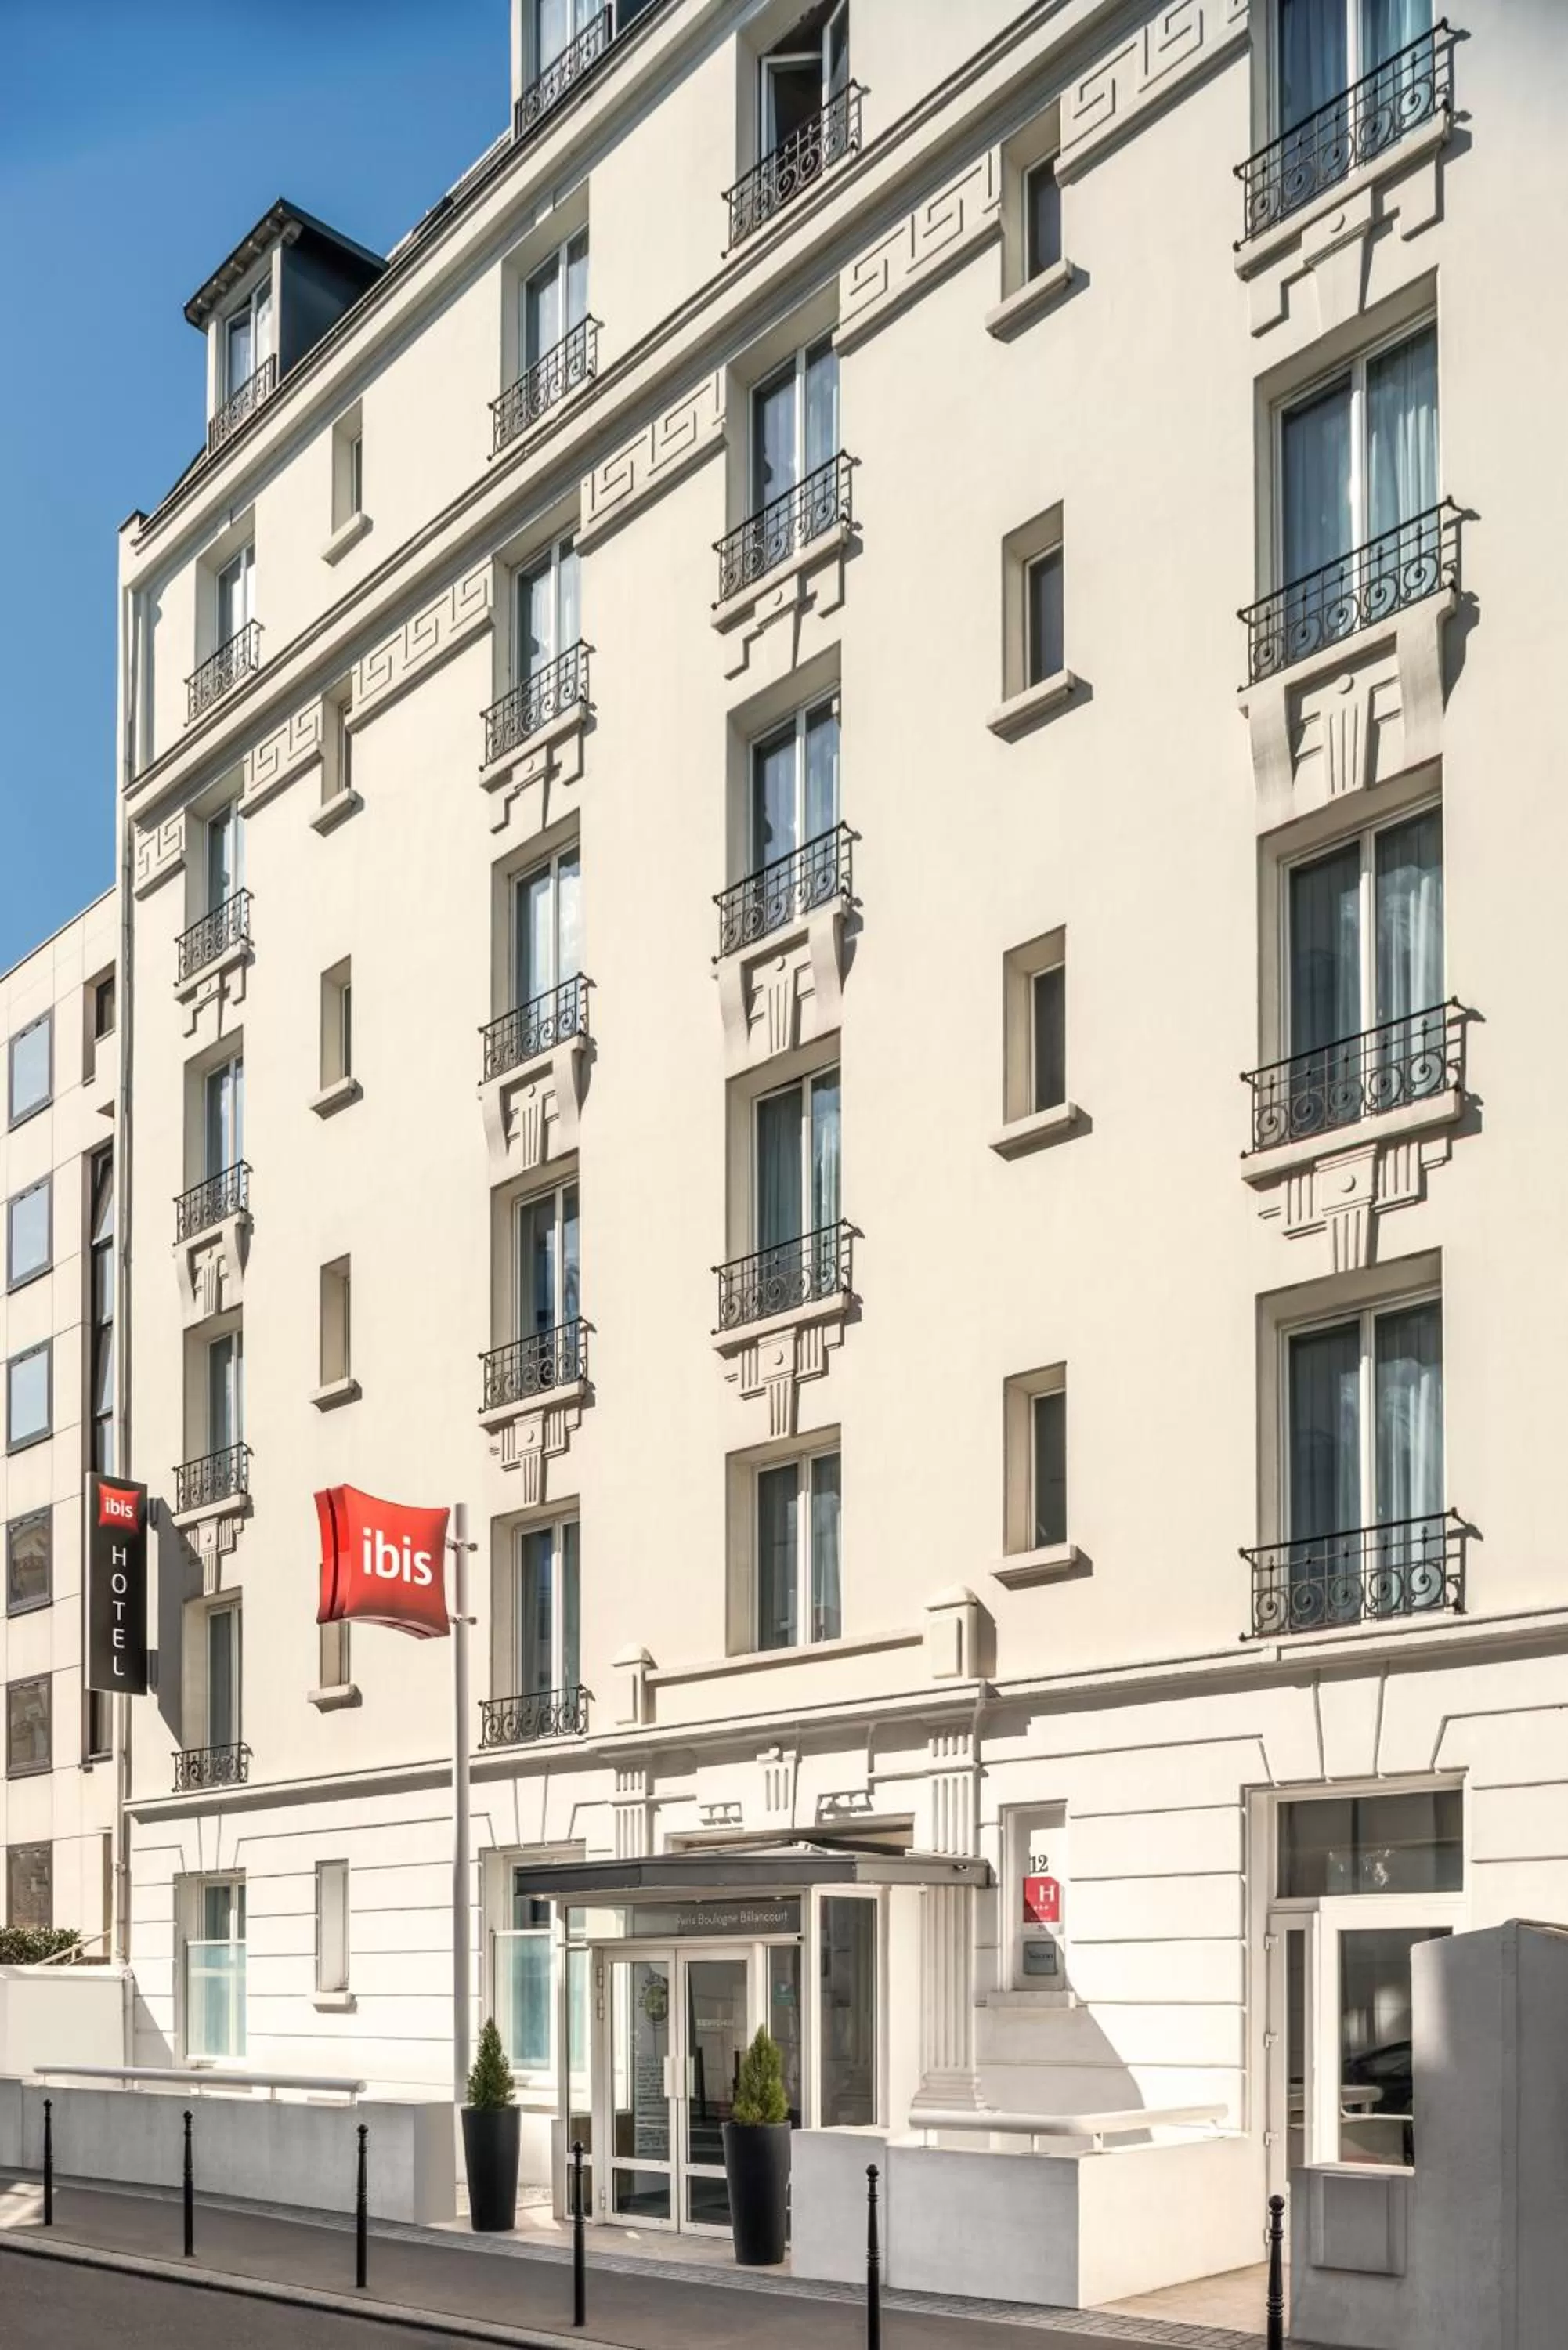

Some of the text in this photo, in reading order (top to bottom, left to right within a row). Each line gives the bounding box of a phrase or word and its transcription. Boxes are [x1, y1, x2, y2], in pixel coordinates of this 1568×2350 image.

[105, 1497, 133, 1518] ibis
[363, 1527, 433, 1586] ibis
[110, 1545, 128, 1676] HOTEL
[1029, 1854, 1049, 1874] 12
[1039, 1885, 1056, 1903] H
[740, 1910, 788, 1924] Billancourt
